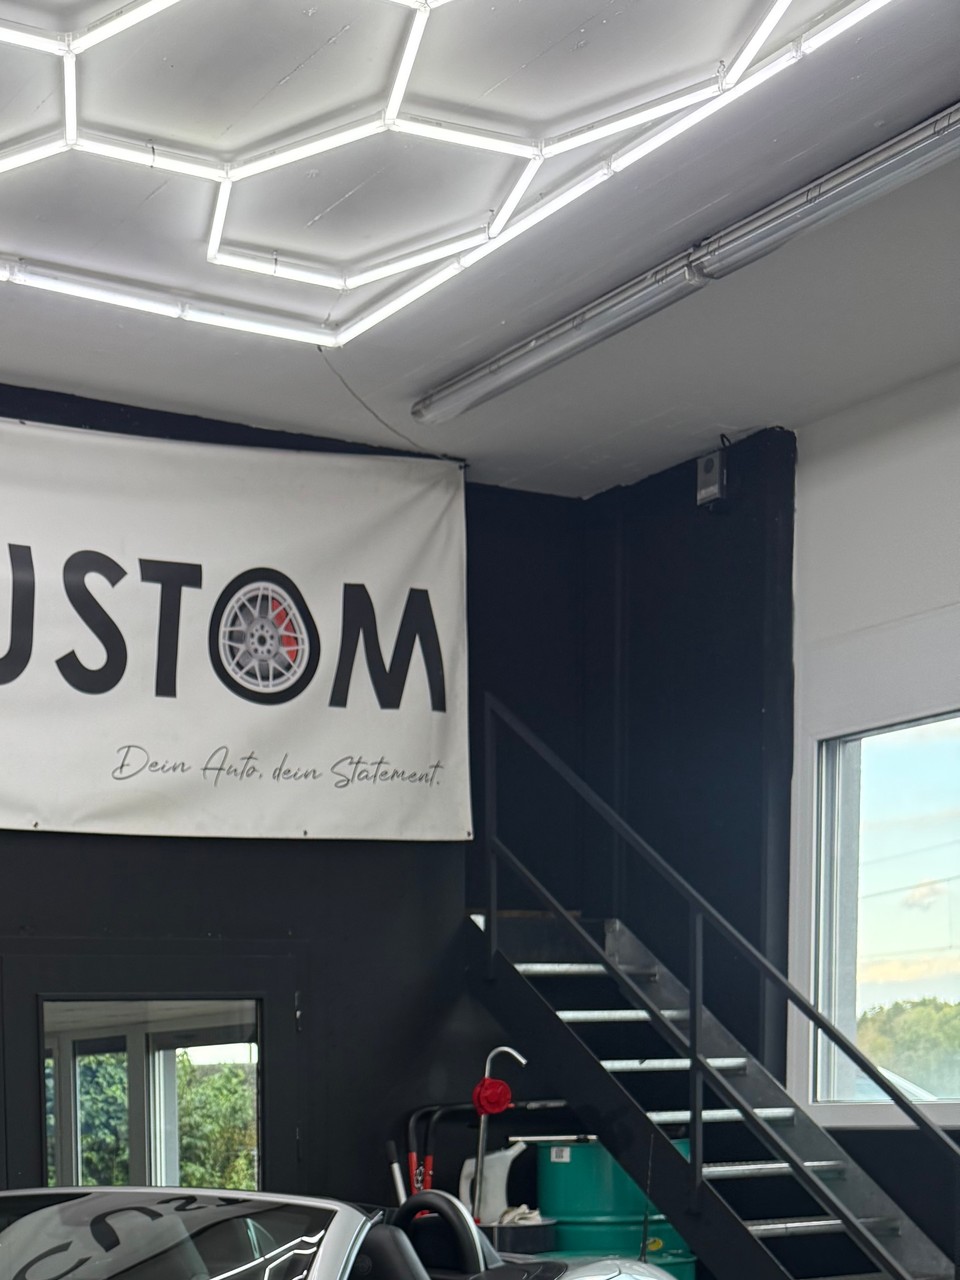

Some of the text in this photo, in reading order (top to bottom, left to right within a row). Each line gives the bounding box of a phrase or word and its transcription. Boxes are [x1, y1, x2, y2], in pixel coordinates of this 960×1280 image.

[112, 745, 192, 781] Dein
[272, 753, 322, 783] dein
[330, 755, 445, 789] Statement.
